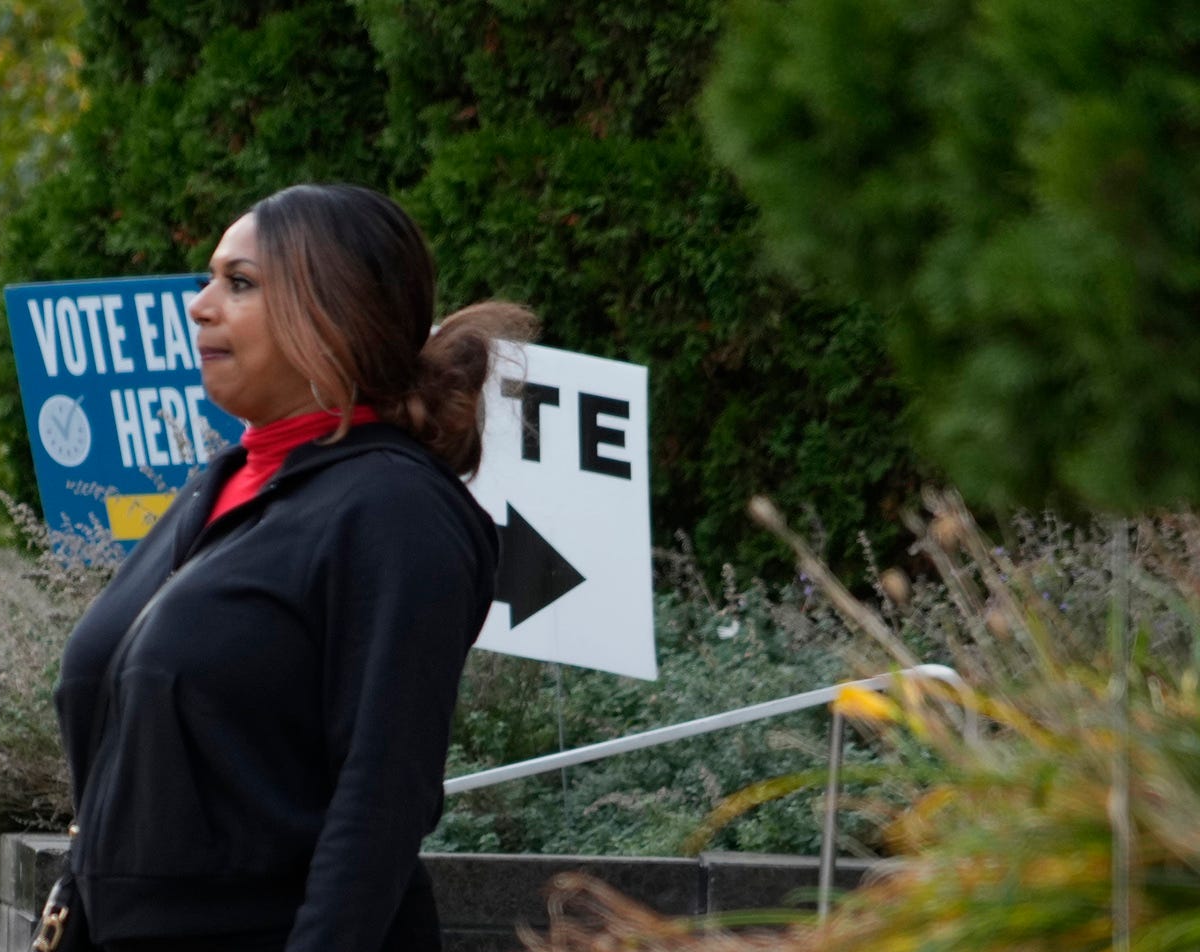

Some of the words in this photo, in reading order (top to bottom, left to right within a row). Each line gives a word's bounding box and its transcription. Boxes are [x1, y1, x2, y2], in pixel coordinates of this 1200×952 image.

[27, 295, 135, 377] VOTE
[110, 385, 214, 468] HERE
[477, 376, 632, 481] TE
